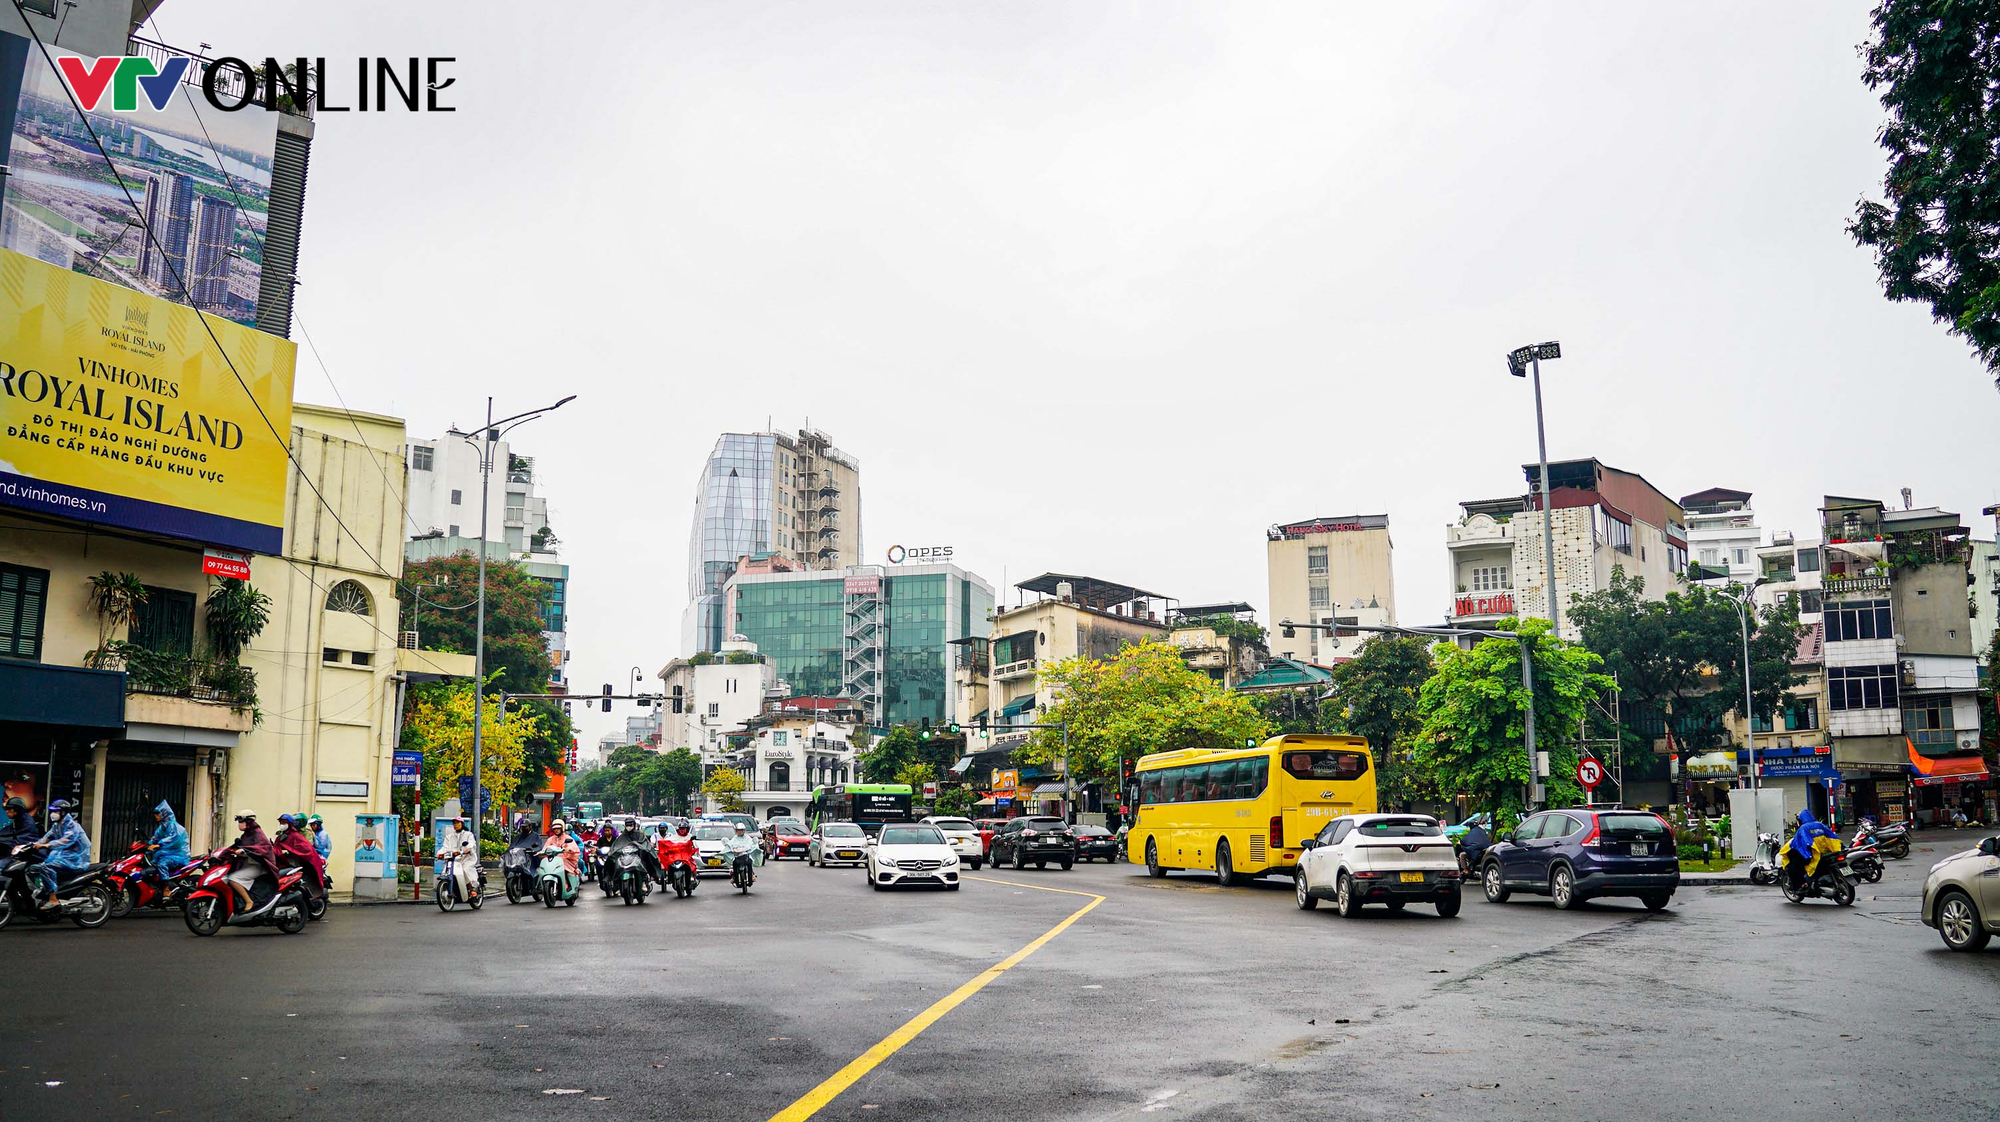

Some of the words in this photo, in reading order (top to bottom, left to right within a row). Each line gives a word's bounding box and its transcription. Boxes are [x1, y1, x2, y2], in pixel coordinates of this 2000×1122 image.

[101, 326, 131, 343] ROYAL
[133, 335, 166, 353] ISLAND
[78, 356, 180, 399] VINHOMES
[0, 361, 115, 421] ROYAL
[122, 395, 243, 450] ISLAND
[32, 413, 54, 428] ĐÔ
[60, 420, 84, 437] THỊ
[162, 444, 208, 463] DƯỠNG
[56, 436, 86, 452] CẤP
[90, 445, 130, 463] HÀNG
[167, 462, 194, 477] KHU
[198, 468, 225, 484] VỰC
[1336, 523, 1364, 533] HOTEL
[908, 546, 953, 558] OPES
[764, 750, 793, 759] EuroStyle
